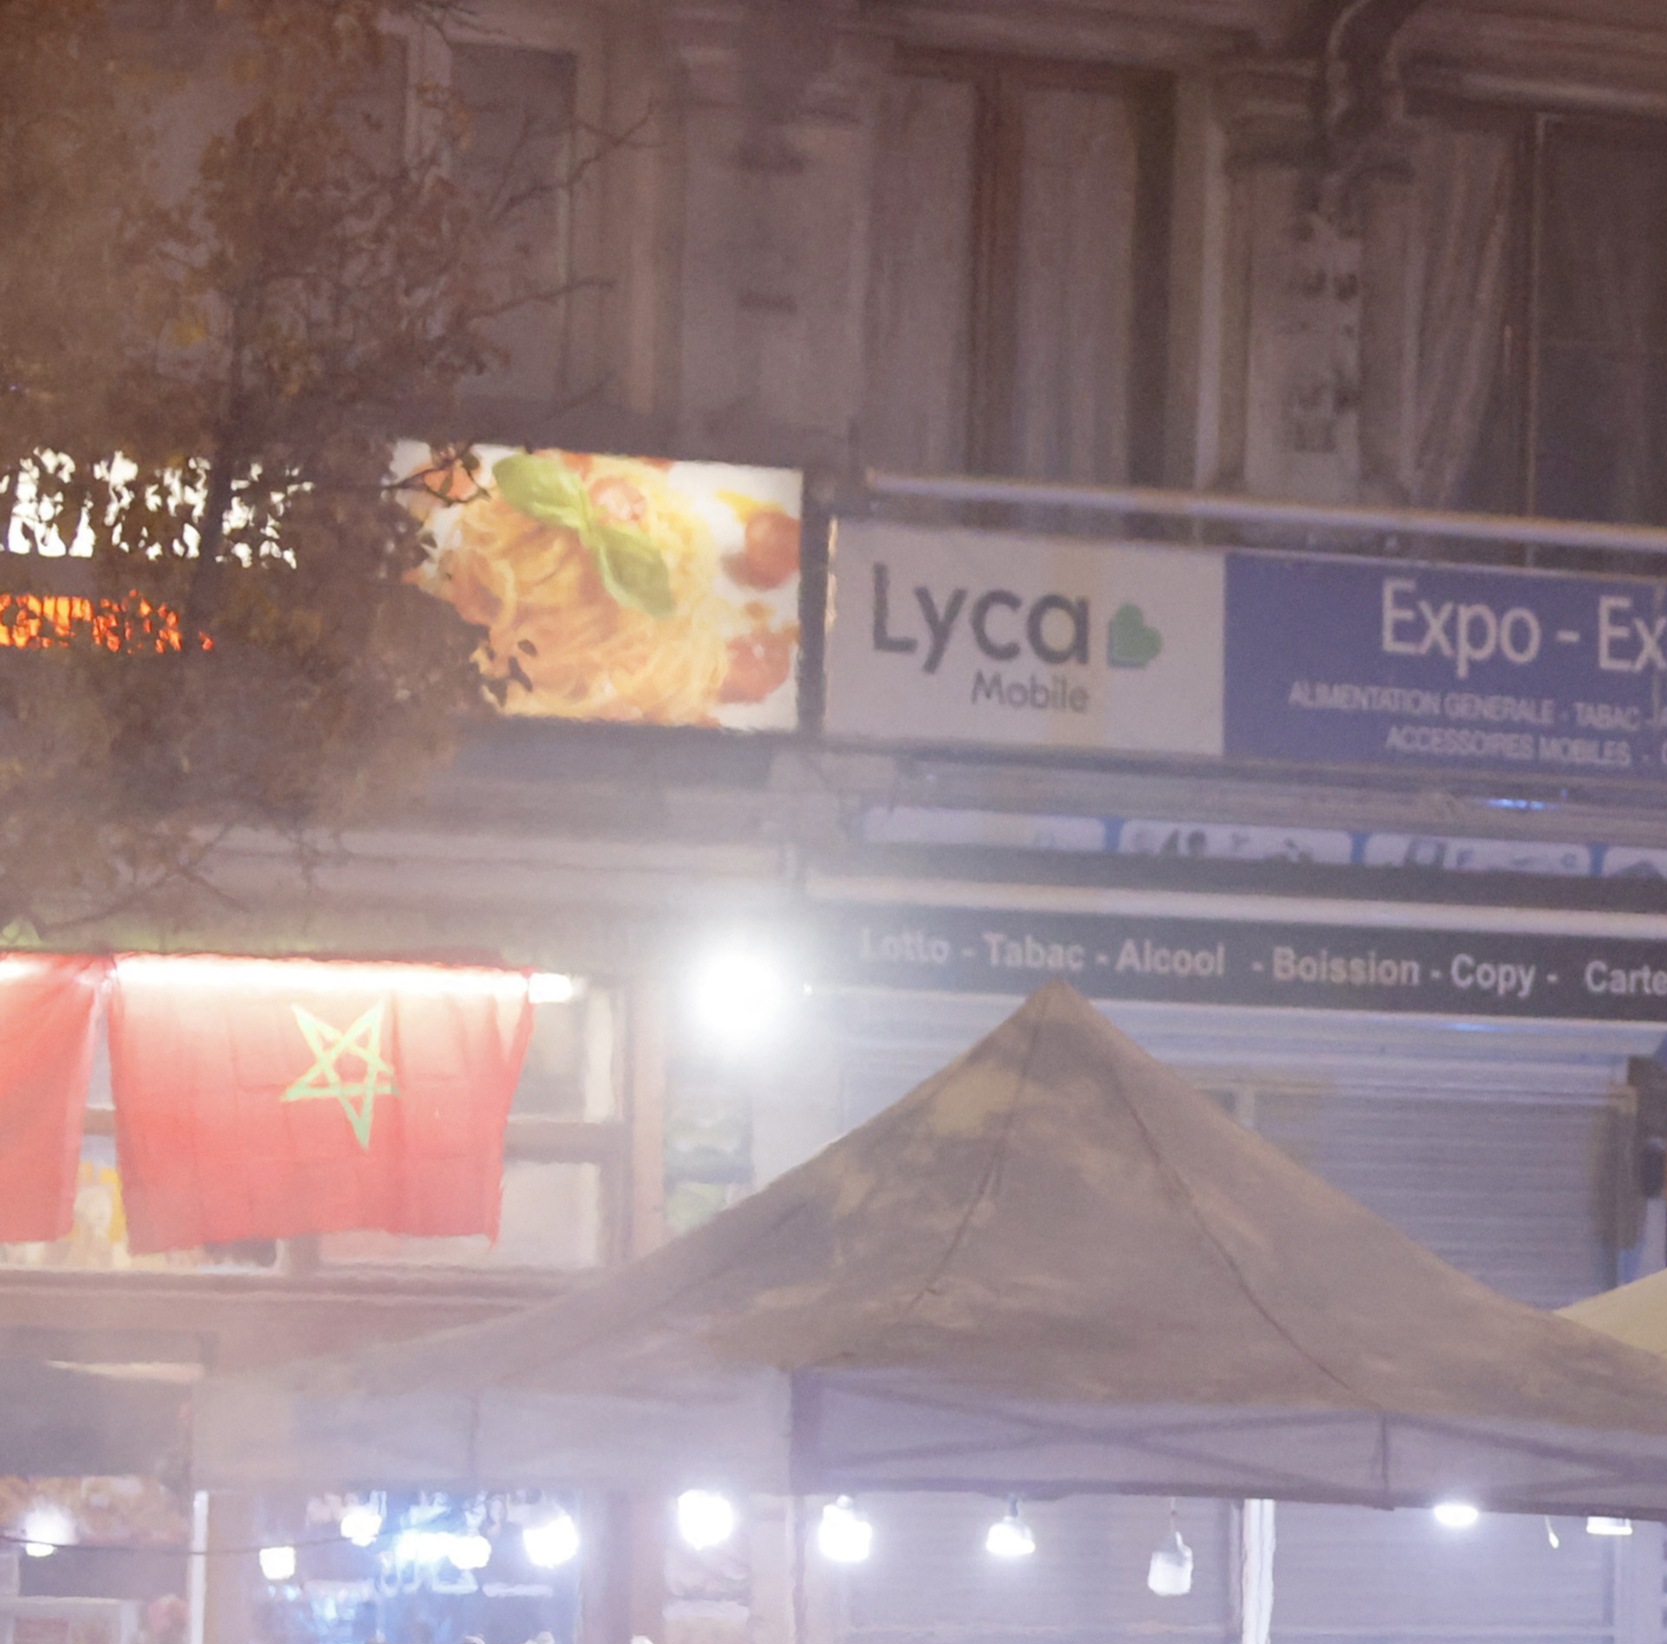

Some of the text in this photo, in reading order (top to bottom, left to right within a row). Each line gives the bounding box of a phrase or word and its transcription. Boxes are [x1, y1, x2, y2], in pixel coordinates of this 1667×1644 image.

[872, 562, 1091, 674] Lyca
[1382, 578, 1542, 679] Expo
[971, 669, 1091, 715] Mobile
[1287, 680, 1441, 714] ALIMENTATION
[1444, 690, 1555, 724] GENERALE
[1573, 701, 1640, 731] TABAC
[1385, 725, 1534, 760] ACCESSOIRES
[1538, 736, 1632, 766] MOBILES
[860, 926, 951, 964] Lotto
[981, 931, 1084, 973] Tabac
[1117, 938, 1225, 978] Alcool
[1272, 946, 1420, 987] Boission
[1451, 954, 1536, 997] Copy
